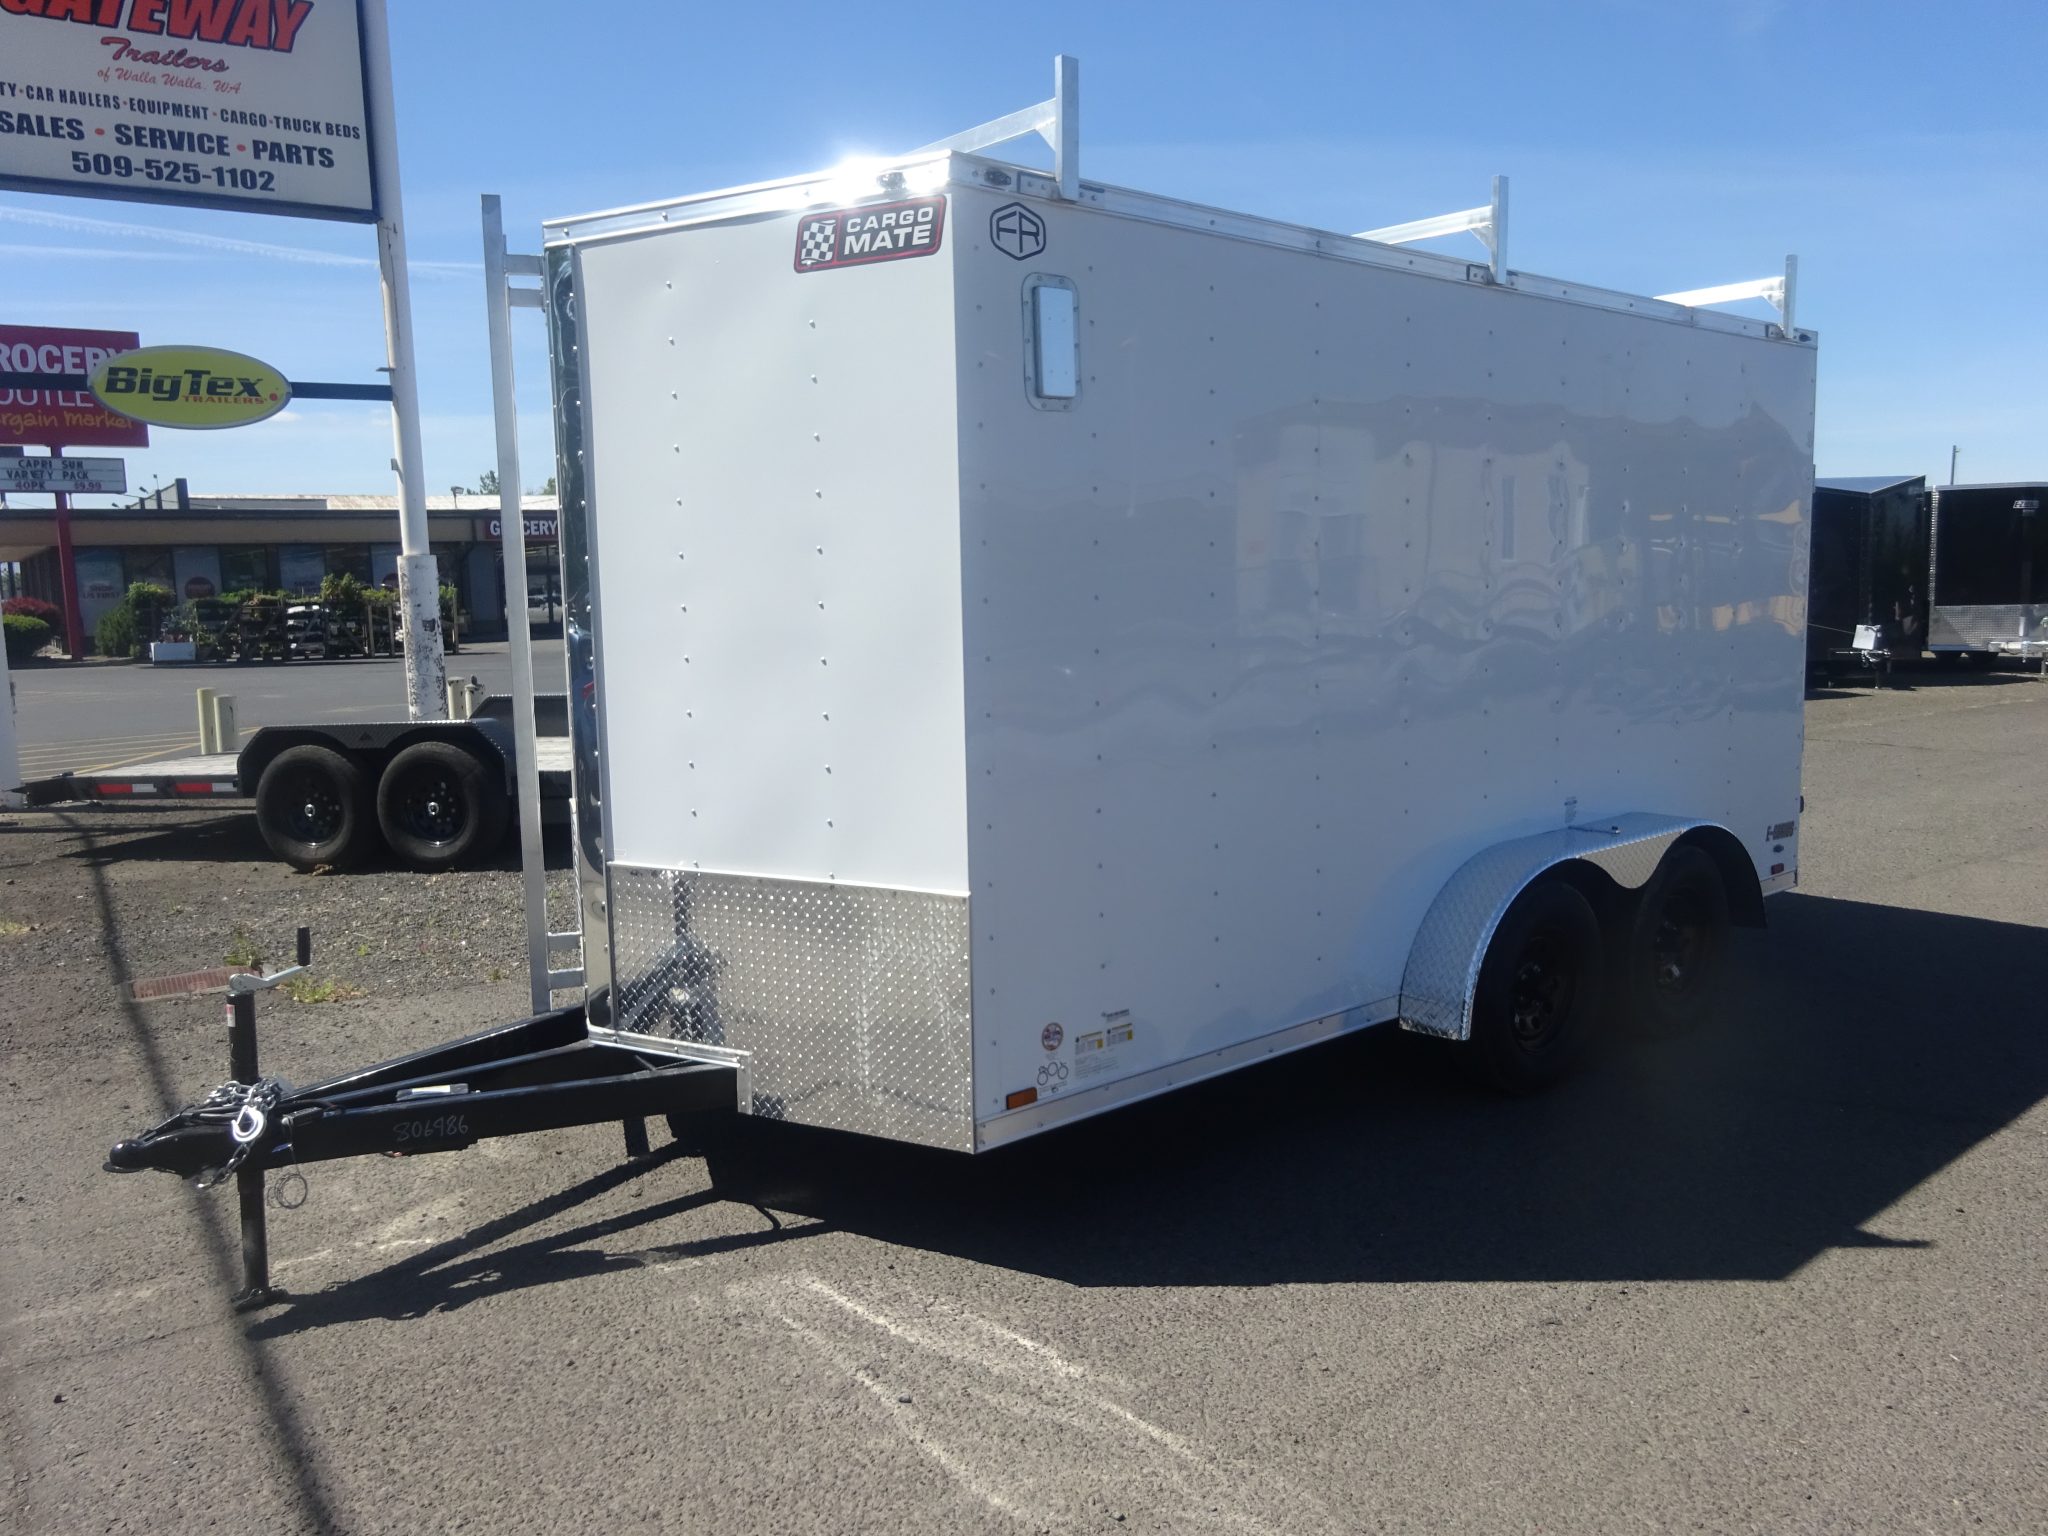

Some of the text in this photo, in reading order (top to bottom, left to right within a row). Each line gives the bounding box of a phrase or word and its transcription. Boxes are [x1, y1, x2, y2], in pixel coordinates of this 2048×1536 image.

[0, 0, 313, 53] TEWAY
[100, 36, 229, 72] Trailers
[97, 66, 110, 82] of
[115, 68, 156, 85] Walla
[213, 79, 242, 95] WA
[26, 85, 54, 102] CAR
[59, 89, 121, 109] HAULERS
[129, 97, 209, 121] EQUIPMENT
[220, 108, 267, 128] CARGO
[274, 115, 321, 135] TRUCK
[325, 122, 361, 140] BEDS
[0, 111, 335, 169] SALES SERVICE PARTS
[71, 150, 276, 192] 509-525-1102
[846, 206, 933, 233] CARGO
[843, 223, 931, 256] MATE
[105, 366, 264, 402] BigTex
[182, 394, 266, 405] TRAILERS
[18, 459, 84, 470] CAPRI SUN
[62, 471, 89, 480] PACK
[490, 520, 558, 536] GCERY
